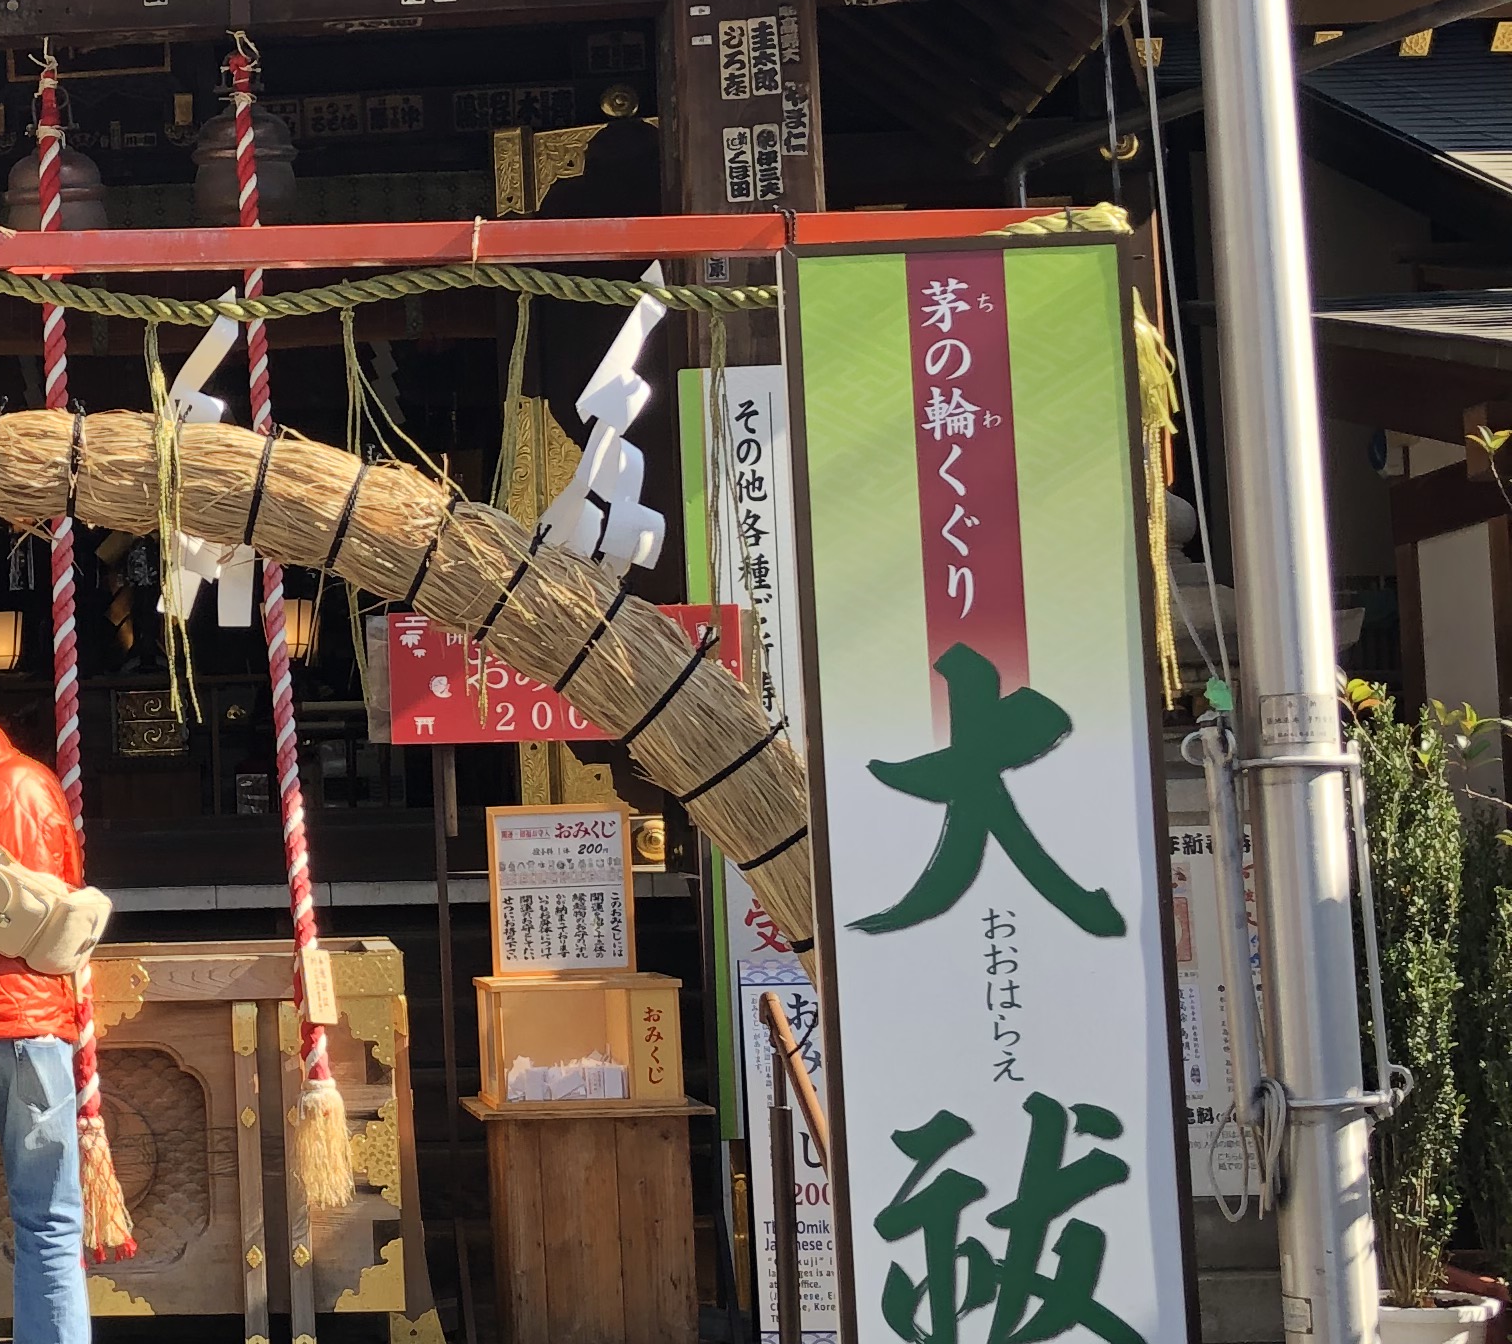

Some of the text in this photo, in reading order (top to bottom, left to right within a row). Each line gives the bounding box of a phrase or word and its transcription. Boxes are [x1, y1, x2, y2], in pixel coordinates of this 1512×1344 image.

[976, 292, 995, 313] ち
[981, 410, 1002, 429] わ
[920, 277, 982, 620] 茅の輪くぐり
[555, 820, 616, 839] おみくじ
[981, 907, 1026, 1084] おおはらえ
[642, 1006, 665, 1086] おみくじ
